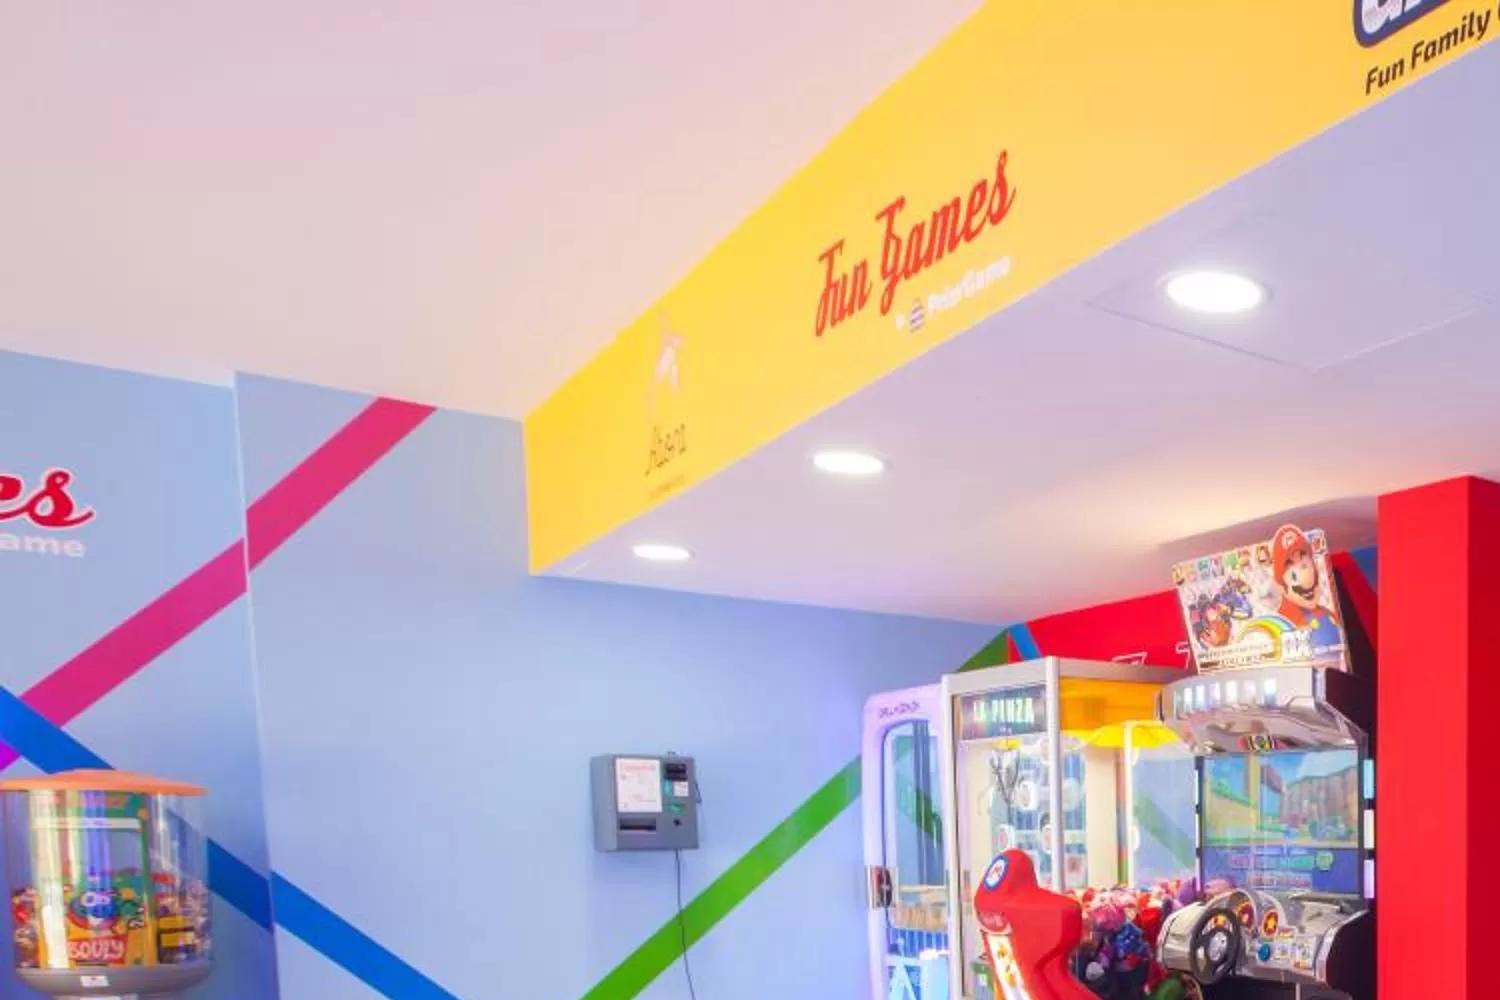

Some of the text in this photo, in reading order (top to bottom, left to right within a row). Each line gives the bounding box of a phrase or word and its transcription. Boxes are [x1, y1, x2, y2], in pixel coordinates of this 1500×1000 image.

[1365, 58, 1405, 96] Fun
[1411, 10, 1491, 69] Family
[816, 148, 1017, 337] Fun Games
